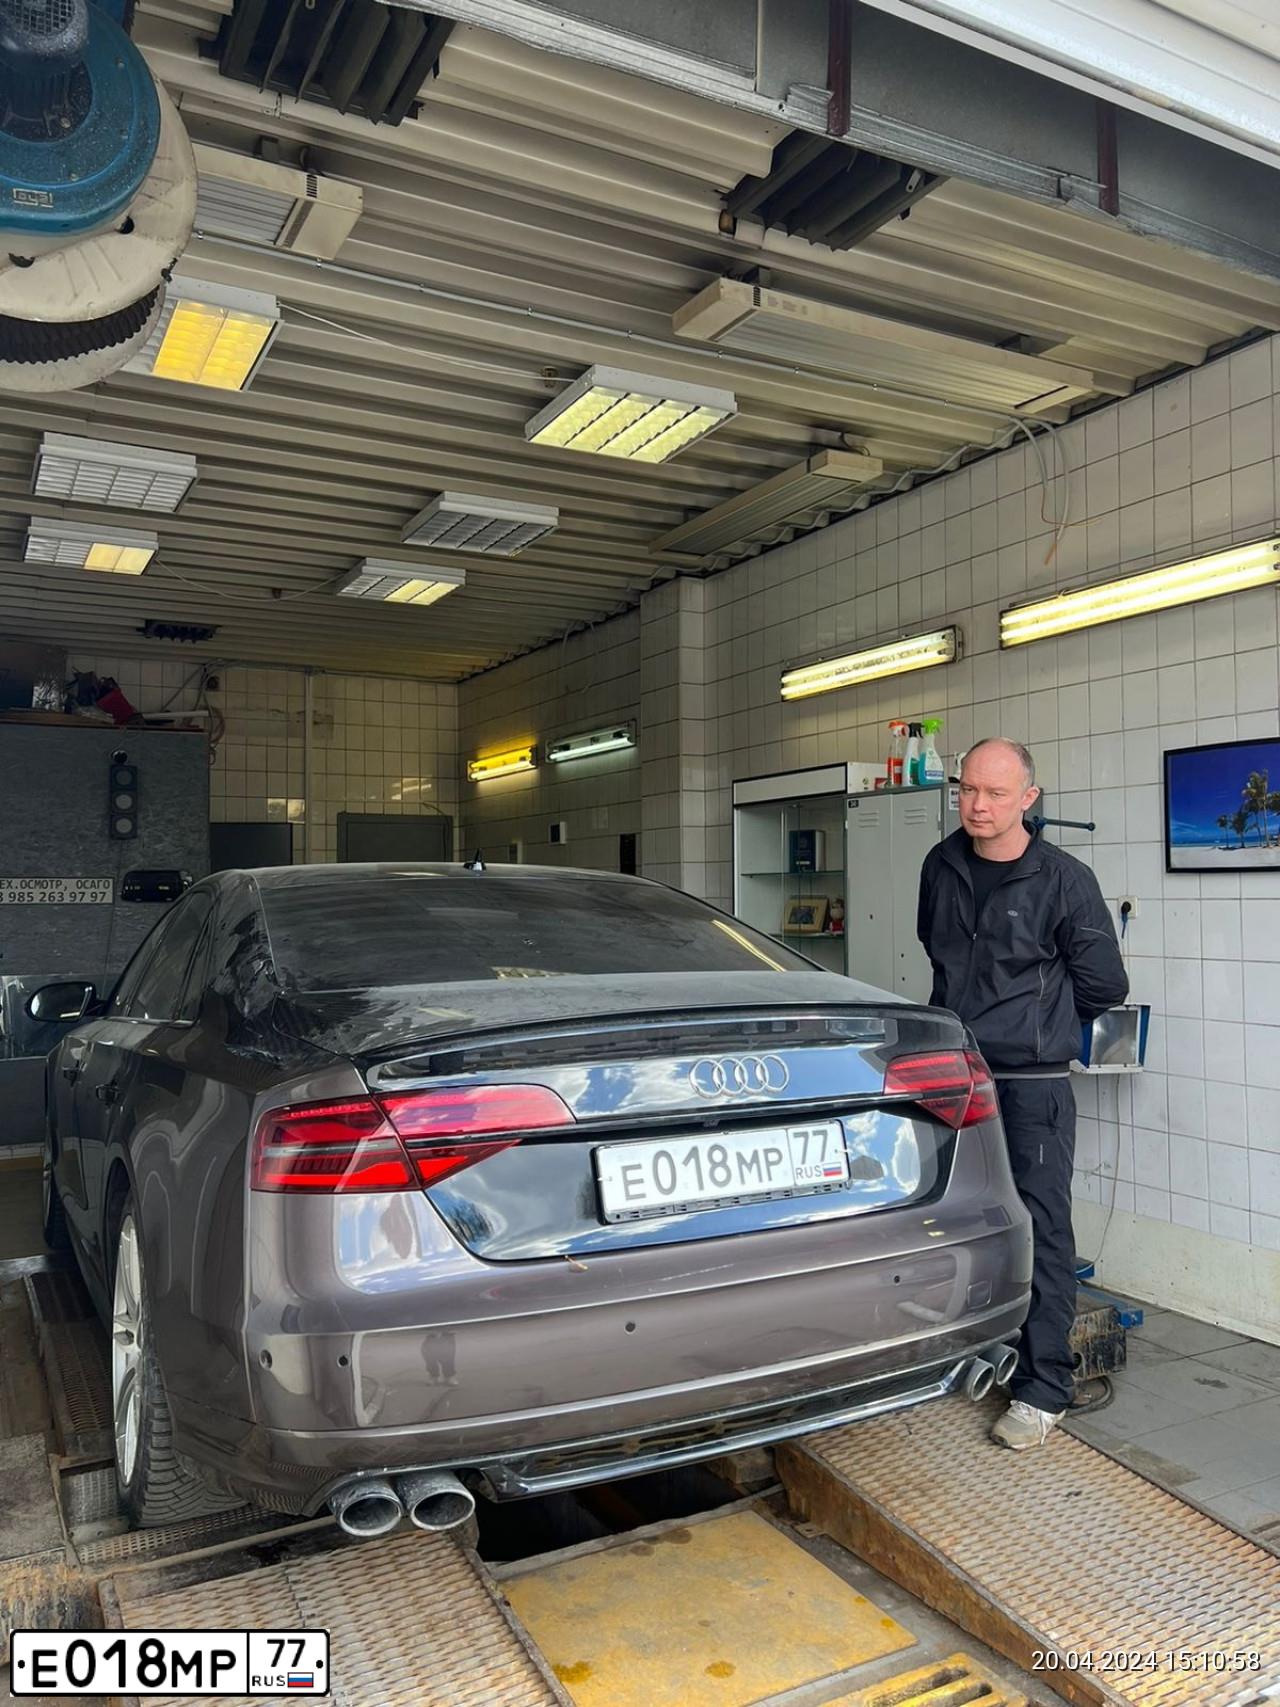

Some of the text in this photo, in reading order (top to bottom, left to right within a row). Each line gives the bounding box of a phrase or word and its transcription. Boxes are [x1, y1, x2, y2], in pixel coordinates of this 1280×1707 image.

[76, 880, 110, 890] ОСАГО
[9, 892, 34, 902] 985
[38, 892, 64, 902] 263
[69, 892, 85, 902] 97
[90, 892, 106, 902] 97
[793, 1129, 829, 1165] 77
[795, 1165, 823, 1180] RUS
